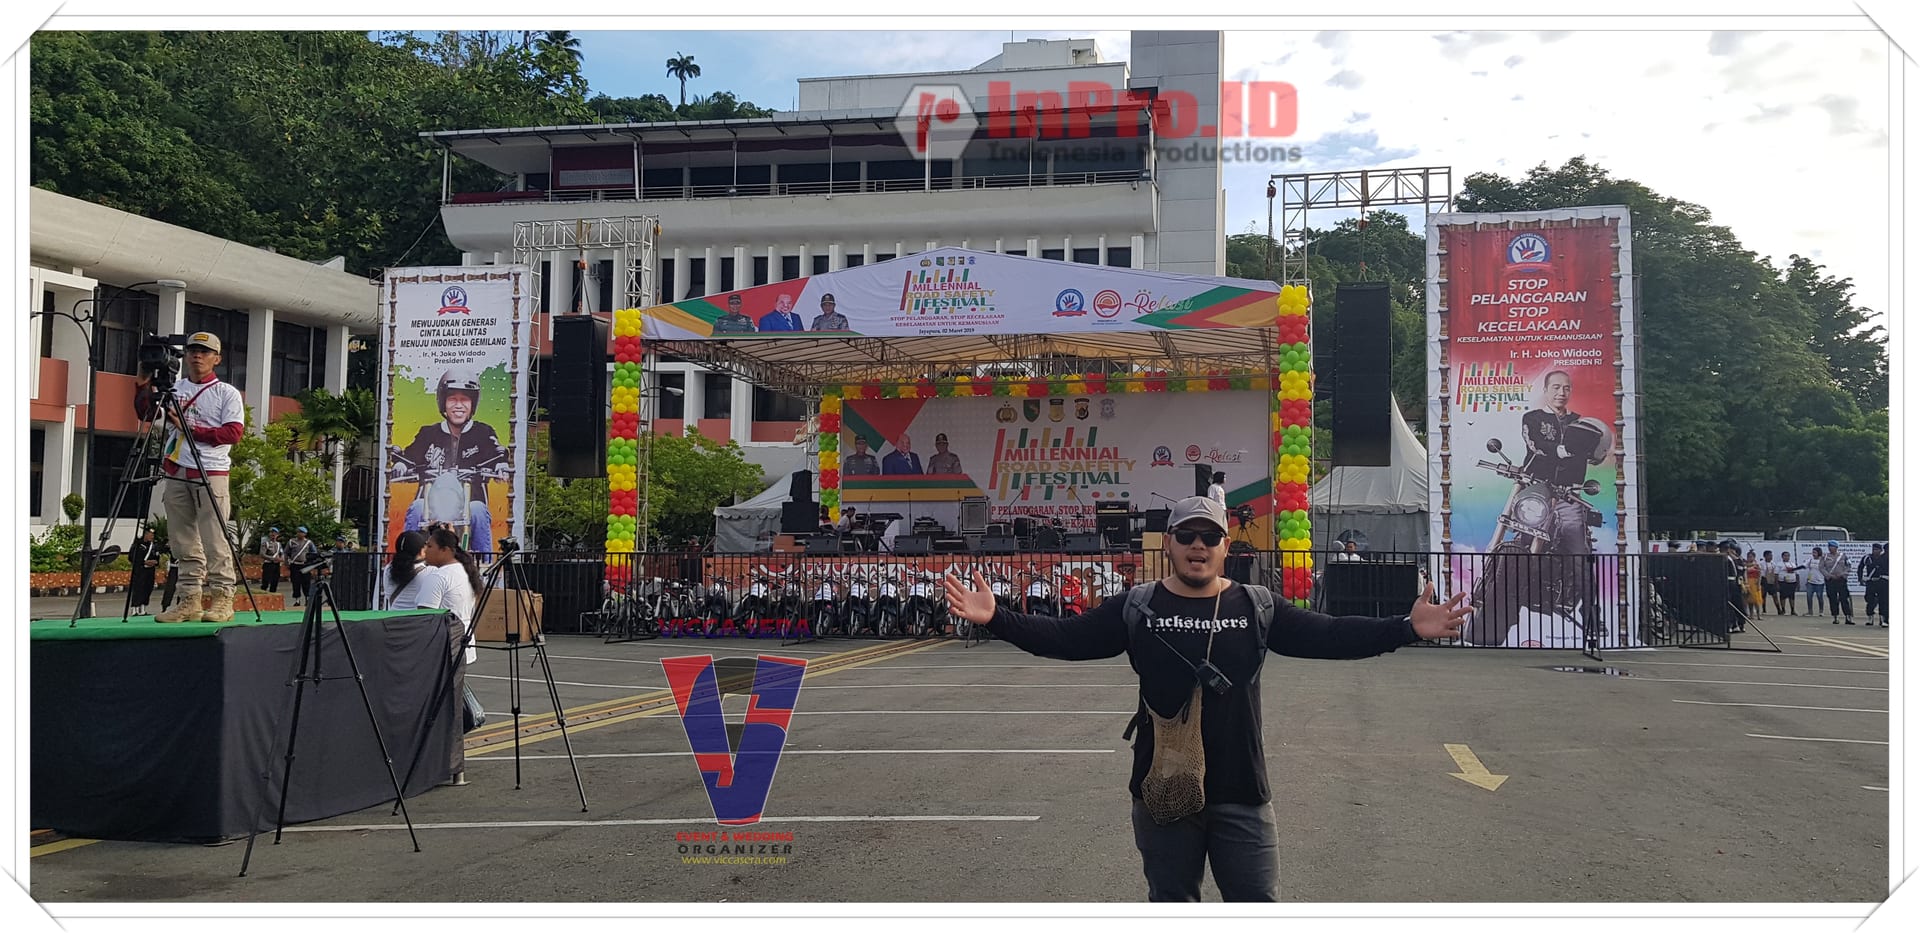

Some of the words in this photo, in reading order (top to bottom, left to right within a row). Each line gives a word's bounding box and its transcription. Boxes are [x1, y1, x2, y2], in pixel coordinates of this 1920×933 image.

[912, 282, 982, 291] MILLENNIAL
[1507, 279, 1549, 290] STOP
[906, 291, 940, 299] ROAD
[944, 290, 996, 298] SAFETY
[1471, 291, 1587, 305] PELANGGARAN
[924, 297, 992, 307] FESTIVAL
[1508, 306, 1549, 318] STOP
[411, 319, 460, 328] MEWUJUDKAN
[461, 318, 497, 327] GENERASI
[1477, 319, 1581, 333] KECELAKAAN
[420, 329, 441, 337] CINTA
[442, 329, 460, 337] LALU
[461, 328, 487, 336] LINTAS
[400, 339, 429, 347] MENUJU
[430, 338, 468, 347] INDONESIA
[469, 337, 507, 346] GEMILANG
[1457, 335, 1514, 343] KESELAMATAN
[1515, 334, 1543, 342] UNTUK
[1543, 333, 1603, 341] KEMANUSIAAN
[1510, 351, 1519, 359] Ir.
[1522, 350, 1532, 358] H.
[1535, 350, 1560, 358] Joko
[1562, 349, 1602, 358] Widodo
[1460, 385, 1489, 393] ROAD
[1492, 385, 1533, 393] SAFETY
[1474, 393, 1528, 402] FESTIVAL
[1004, 447, 1127, 461] MILLENNIAL
[998, 461, 1052, 473] ROAD
[1058, 460, 1136, 472] SAFETY
[1025, 472, 1128, 485] FESTIVAL
[1058, 505, 1079, 515] STOP
